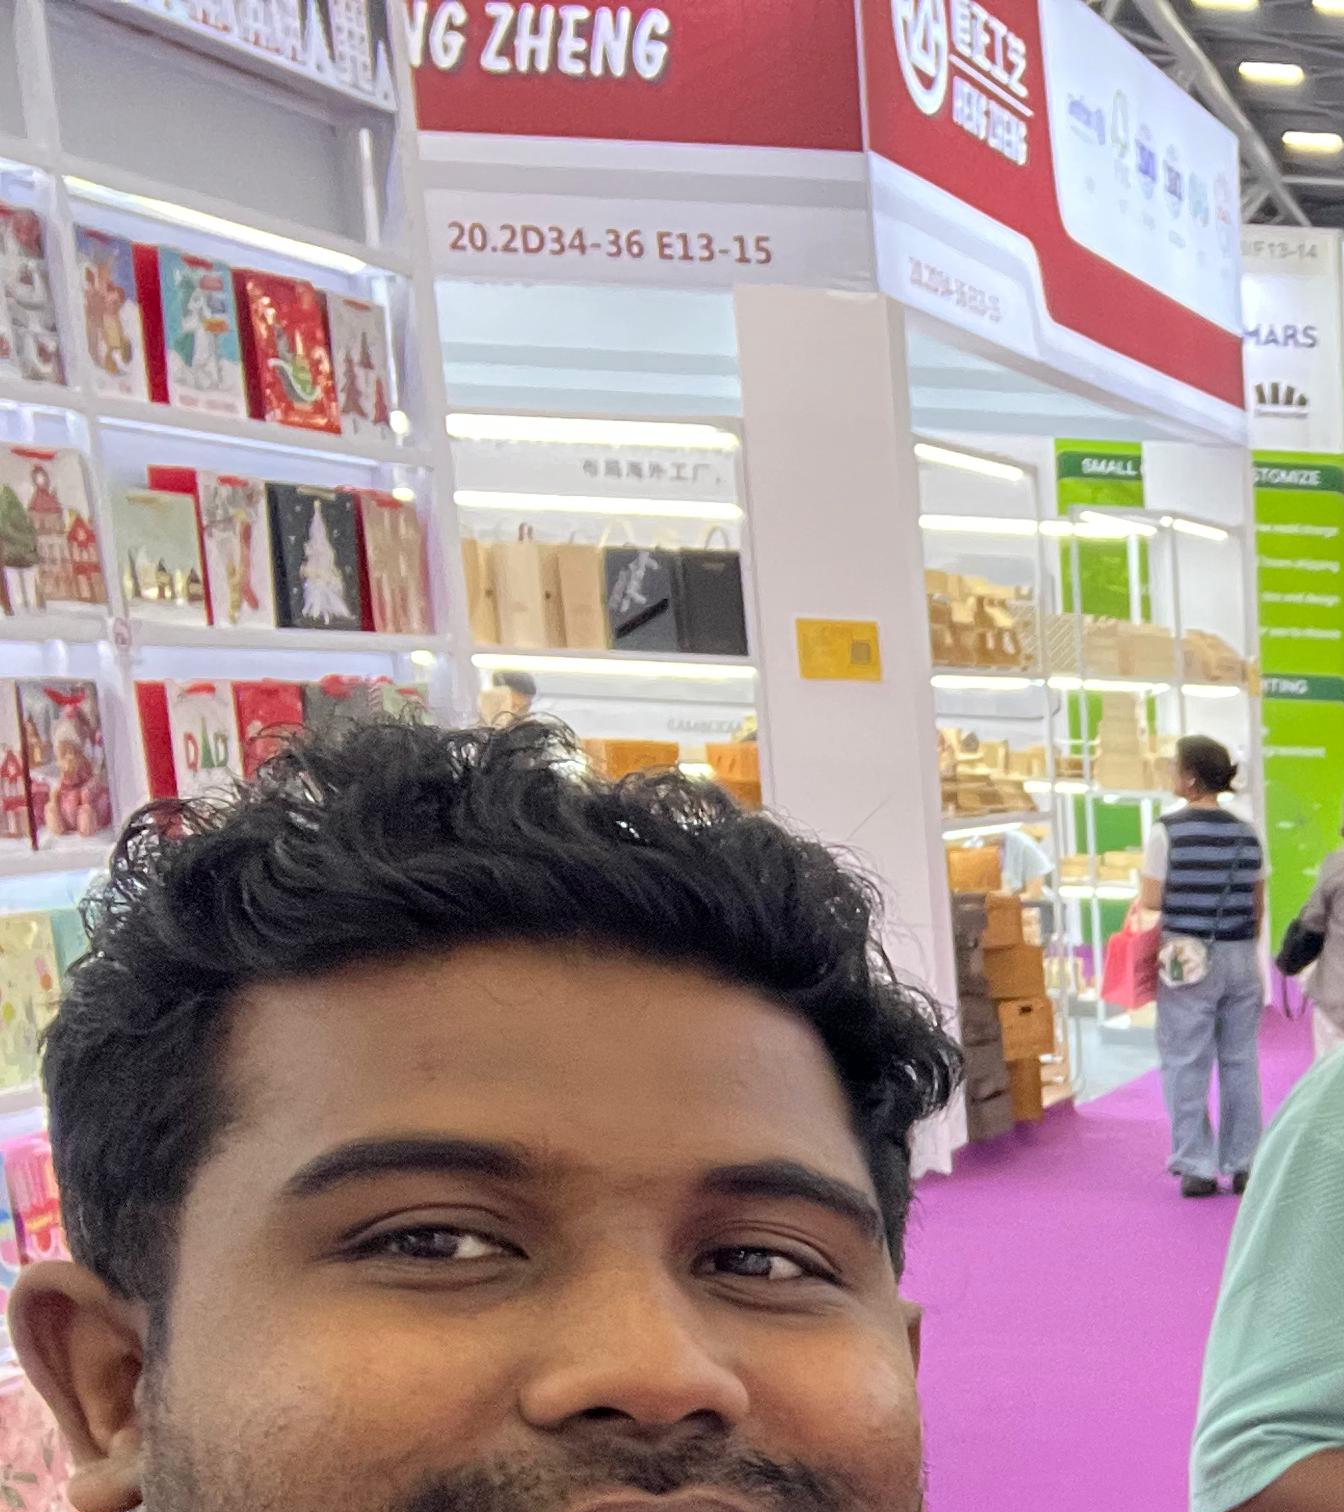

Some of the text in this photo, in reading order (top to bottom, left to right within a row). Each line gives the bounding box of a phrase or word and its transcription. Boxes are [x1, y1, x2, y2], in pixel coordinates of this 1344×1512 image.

[480, 2, 670, 79] ZHENG
[448, 221, 773, 266] 20.2D34-36 E13-15
[1081, 457, 1138, 476] SMALL
